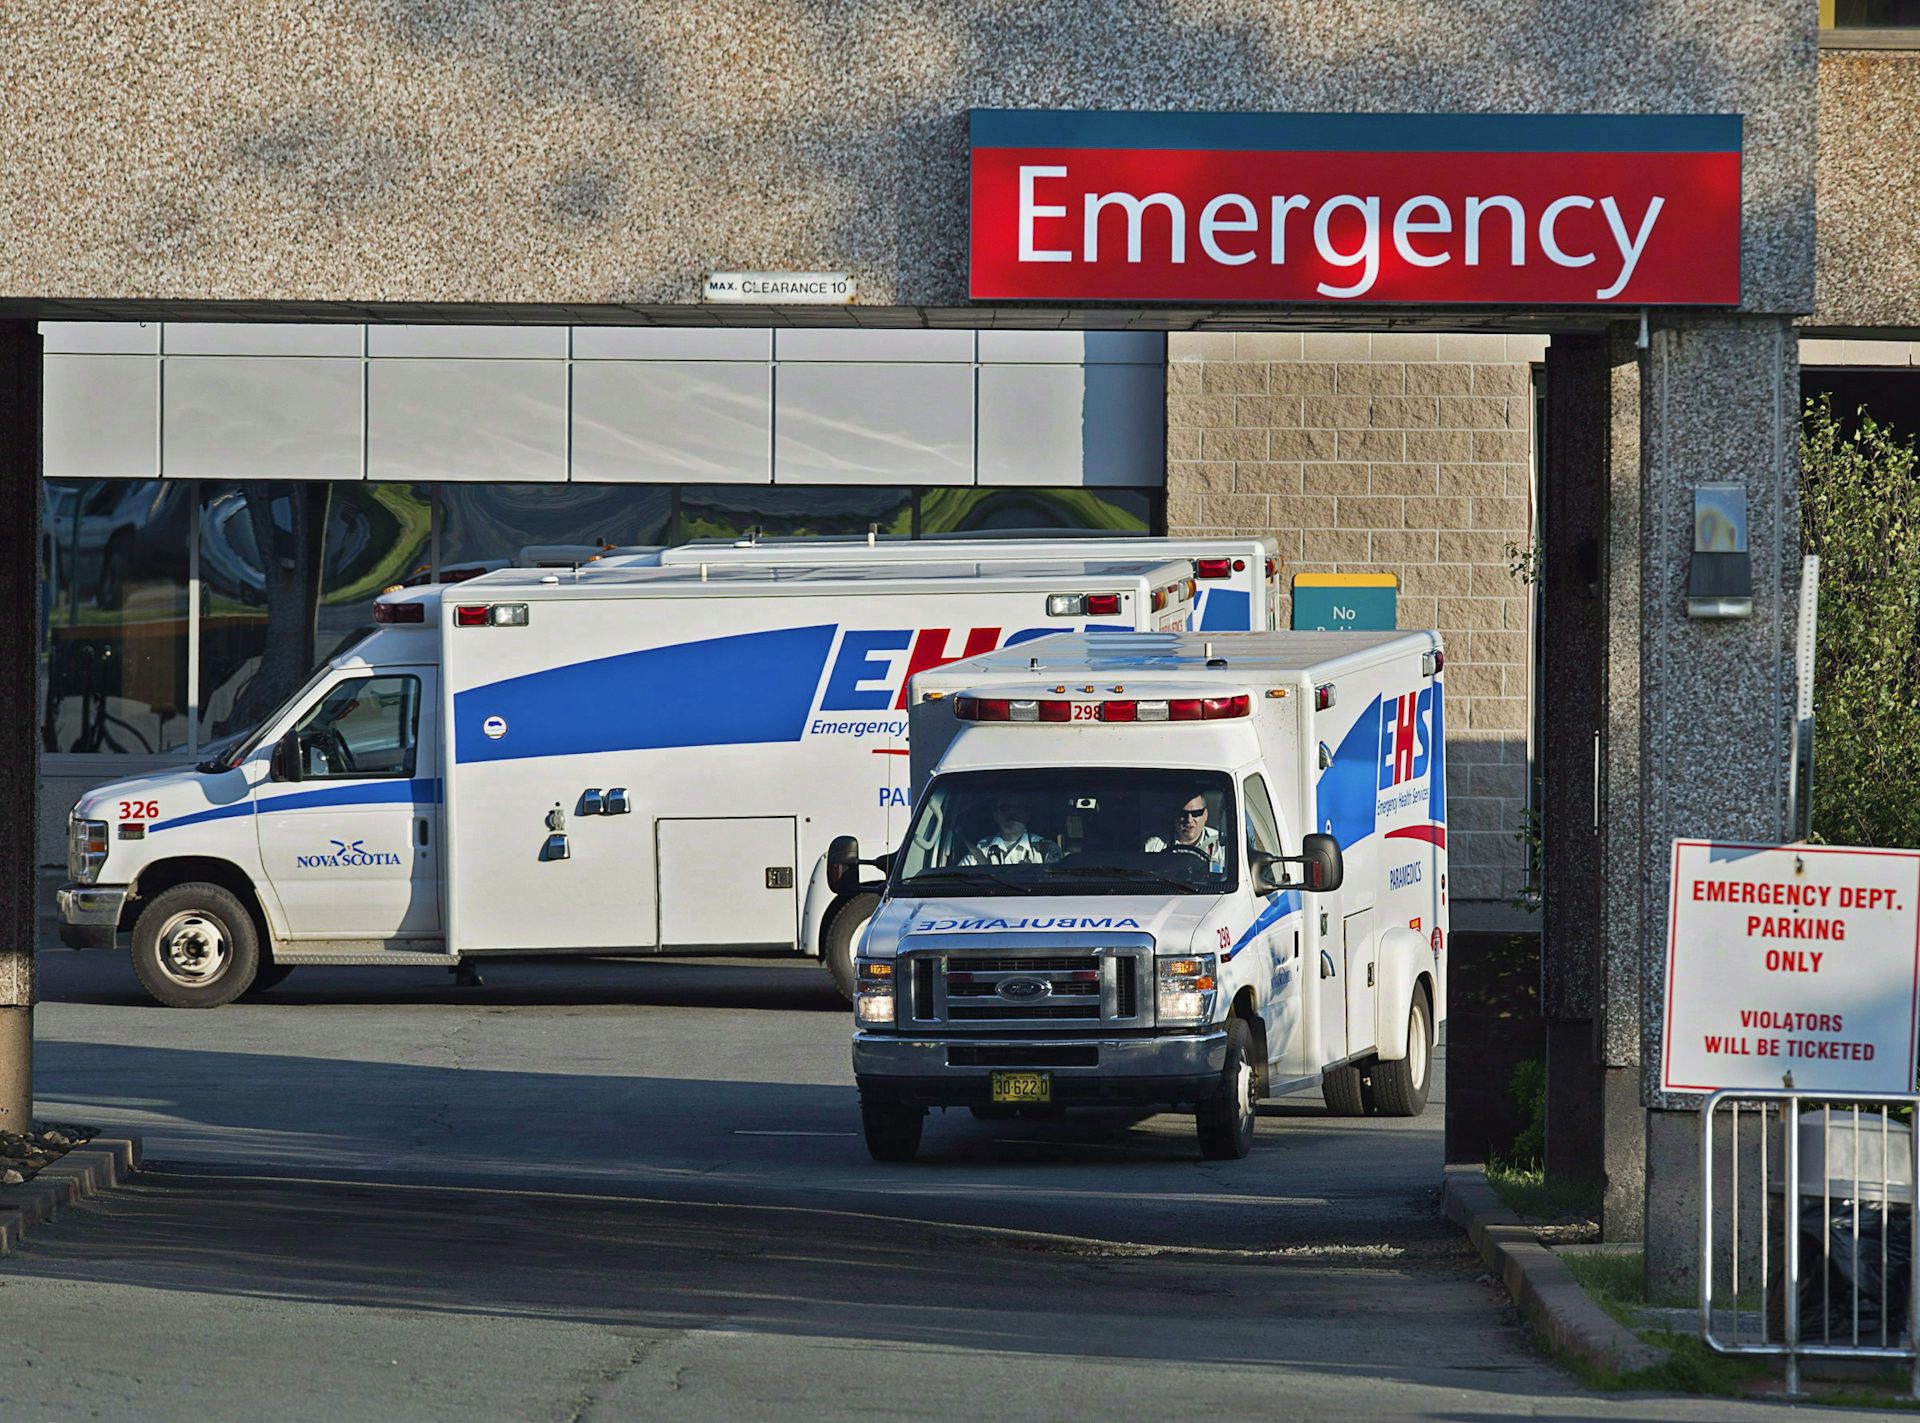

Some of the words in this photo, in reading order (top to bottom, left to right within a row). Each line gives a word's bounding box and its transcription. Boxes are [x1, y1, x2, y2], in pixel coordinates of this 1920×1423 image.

[1017, 165, 1665, 300] Emergency
[709, 282, 737, 291] MAX.
[741, 280, 828, 294] CLEARANCE
[1332, 606, 1356, 620] No
[1073, 704, 1102, 720] 298
[810, 719, 908, 738] Emergency
[1379, 687, 1432, 791] EHS
[118, 800, 159, 820] 326
[1377, 797, 1398, 817] Emergency
[297, 855, 338, 868] NOVA
[342, 852, 402, 867] SCOTIA
[1389, 861, 1422, 891] PARAMEDICS
[1692, 880, 1831, 907] EMERGENCY
[1839, 887, 1903, 911] DEPT.
[1216, 926, 1231, 949] 298
[1747, 916, 1845, 941] PARKING
[1765, 950, 1823, 973] ONLY
[1740, 1010, 1843, 1032] VIOLATORS
[1704, 1036, 1750, 1056] WILL
[1756, 1039, 1780, 1057] BE
[1786, 1040, 1875, 1061] TICKETED
